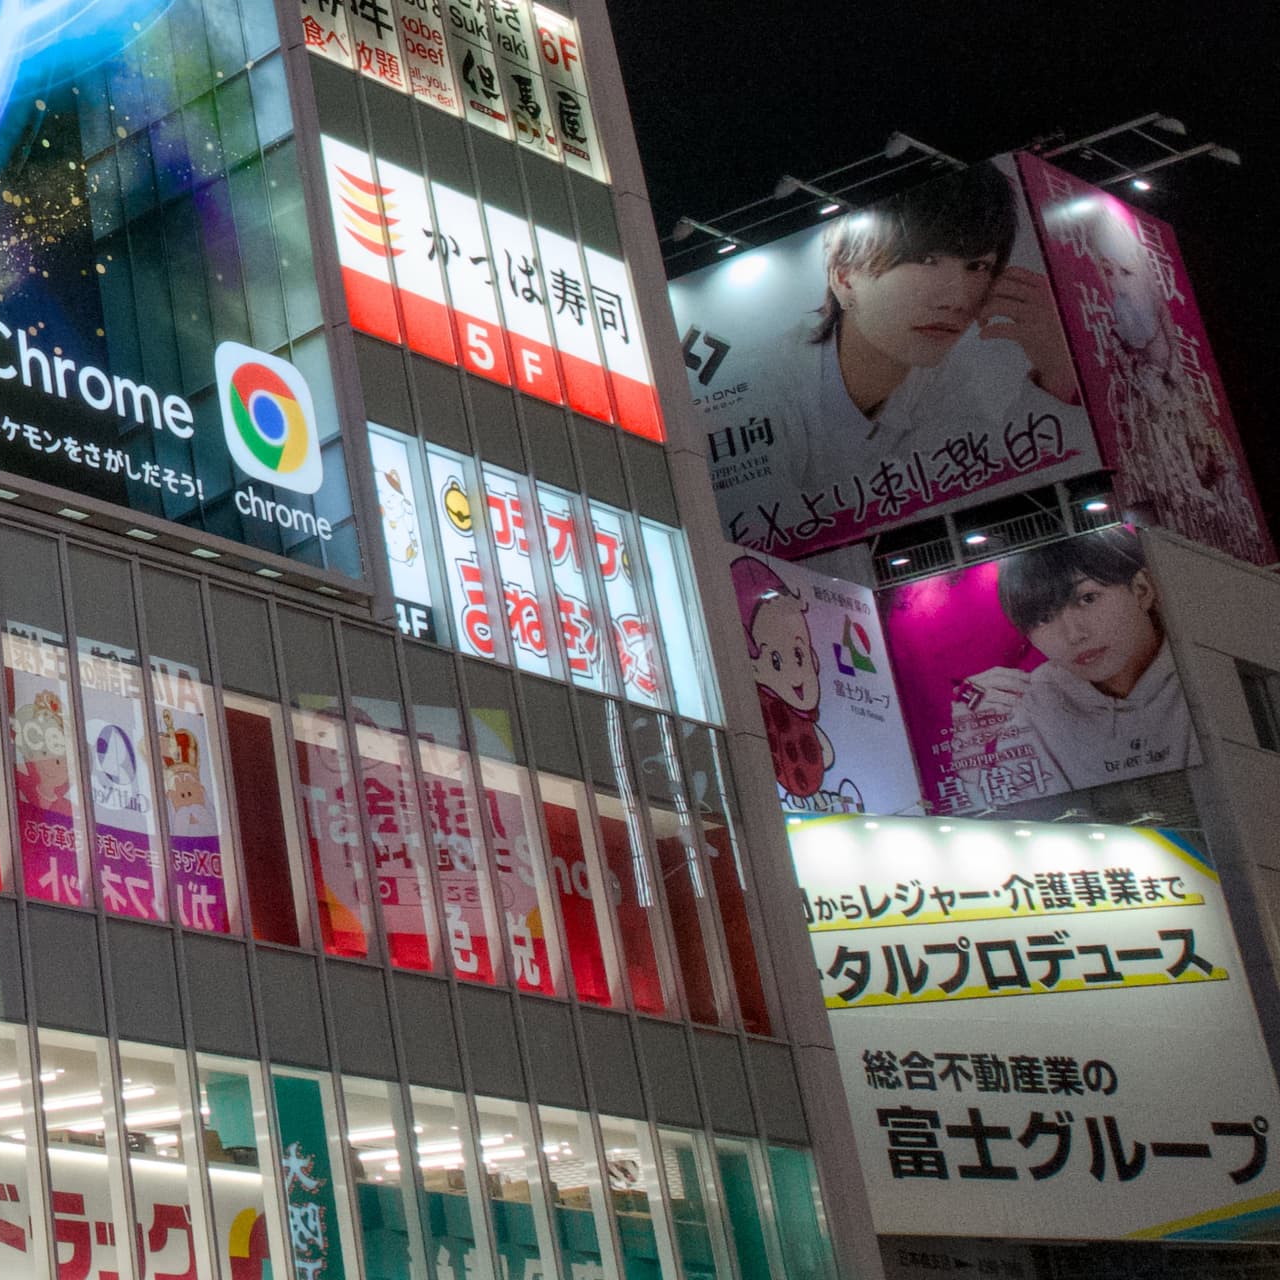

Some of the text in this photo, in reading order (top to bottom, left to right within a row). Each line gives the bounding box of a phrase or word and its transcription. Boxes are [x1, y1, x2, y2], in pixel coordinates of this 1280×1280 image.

[302, 16, 403, 87] 食べ放題
[404, 37, 445, 68] beef
[450, 6, 529, 61] Sukaki
[537, 28, 578, 72] 6F
[465, 322, 545, 384] 5F
[707, 417, 775, 464] 日向
[234, 486, 333, 542] chrome
[818, 928, 1213, 1004] タルプロデュース
[862, 1048, 1119, 1097] 総合不動産業の
[878, 1104, 1269, 1186] 富士グループ
